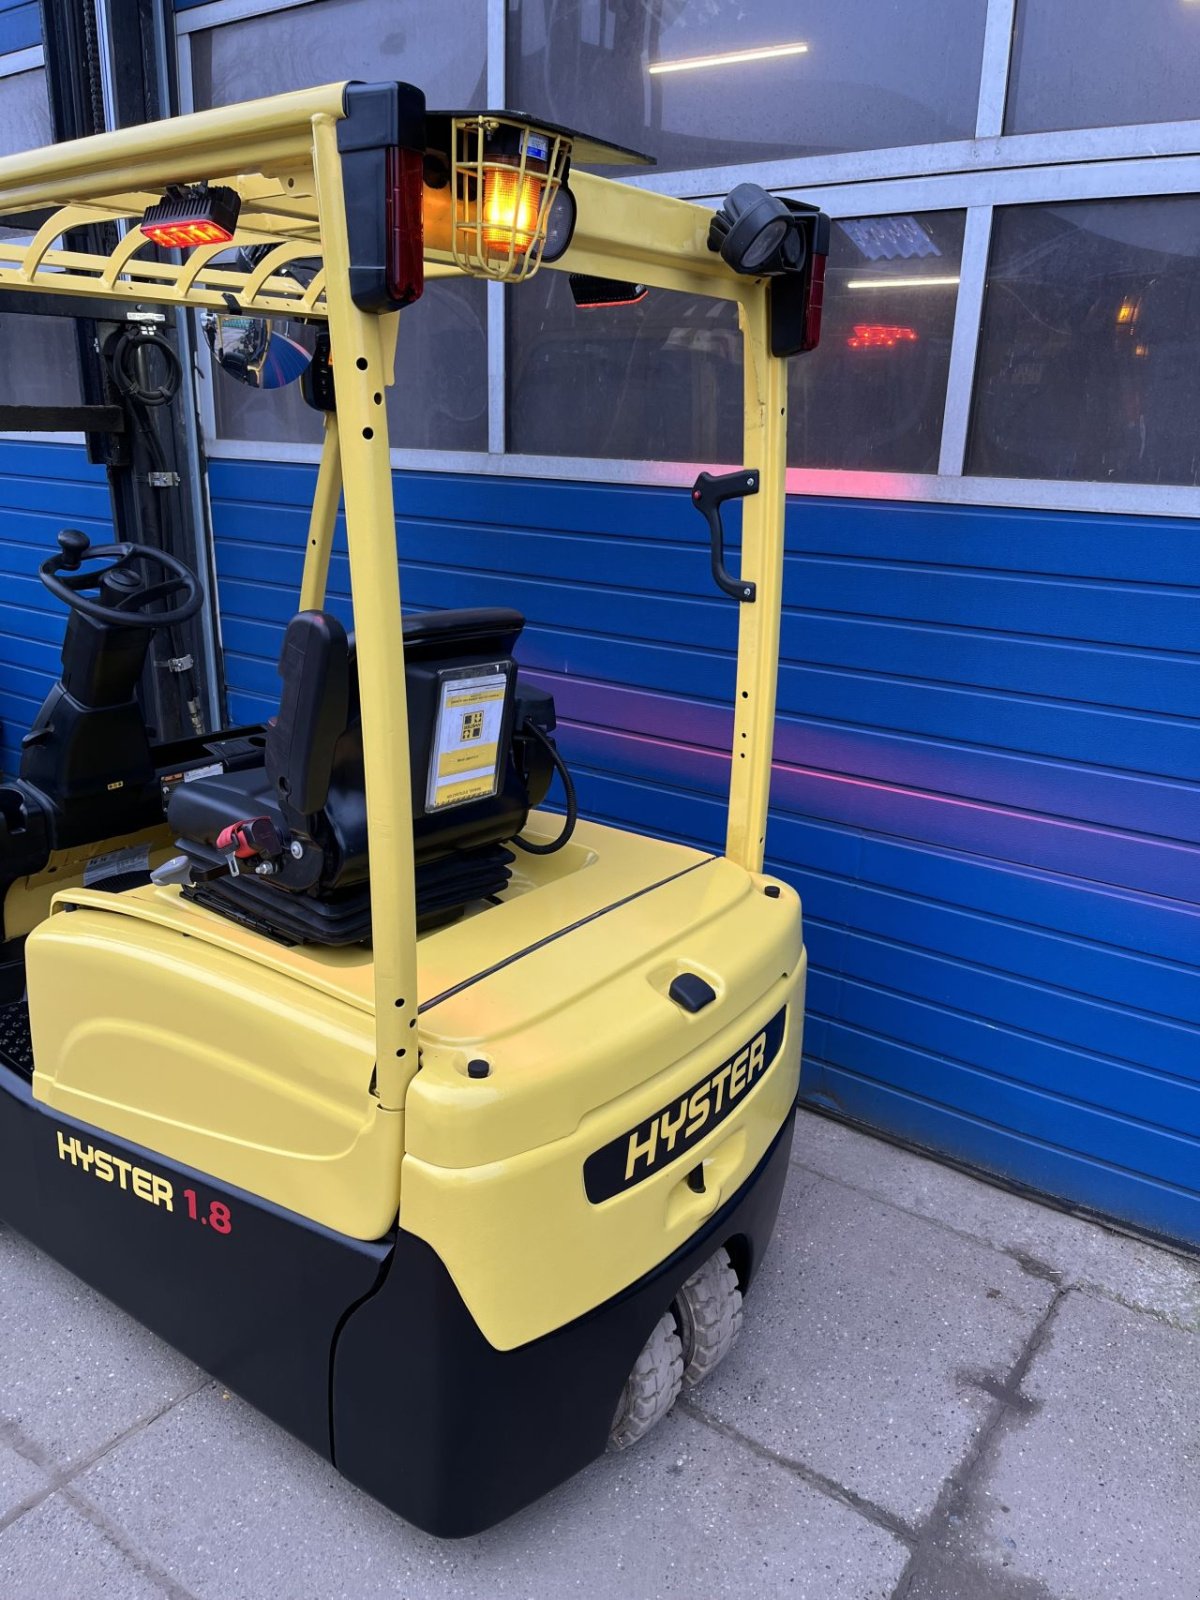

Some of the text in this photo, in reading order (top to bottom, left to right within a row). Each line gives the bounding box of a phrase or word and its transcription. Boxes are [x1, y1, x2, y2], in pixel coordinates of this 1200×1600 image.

[624, 1031, 767, 1181] HYSTER
[56, 1130, 232, 1235] HYSTER 1.8
